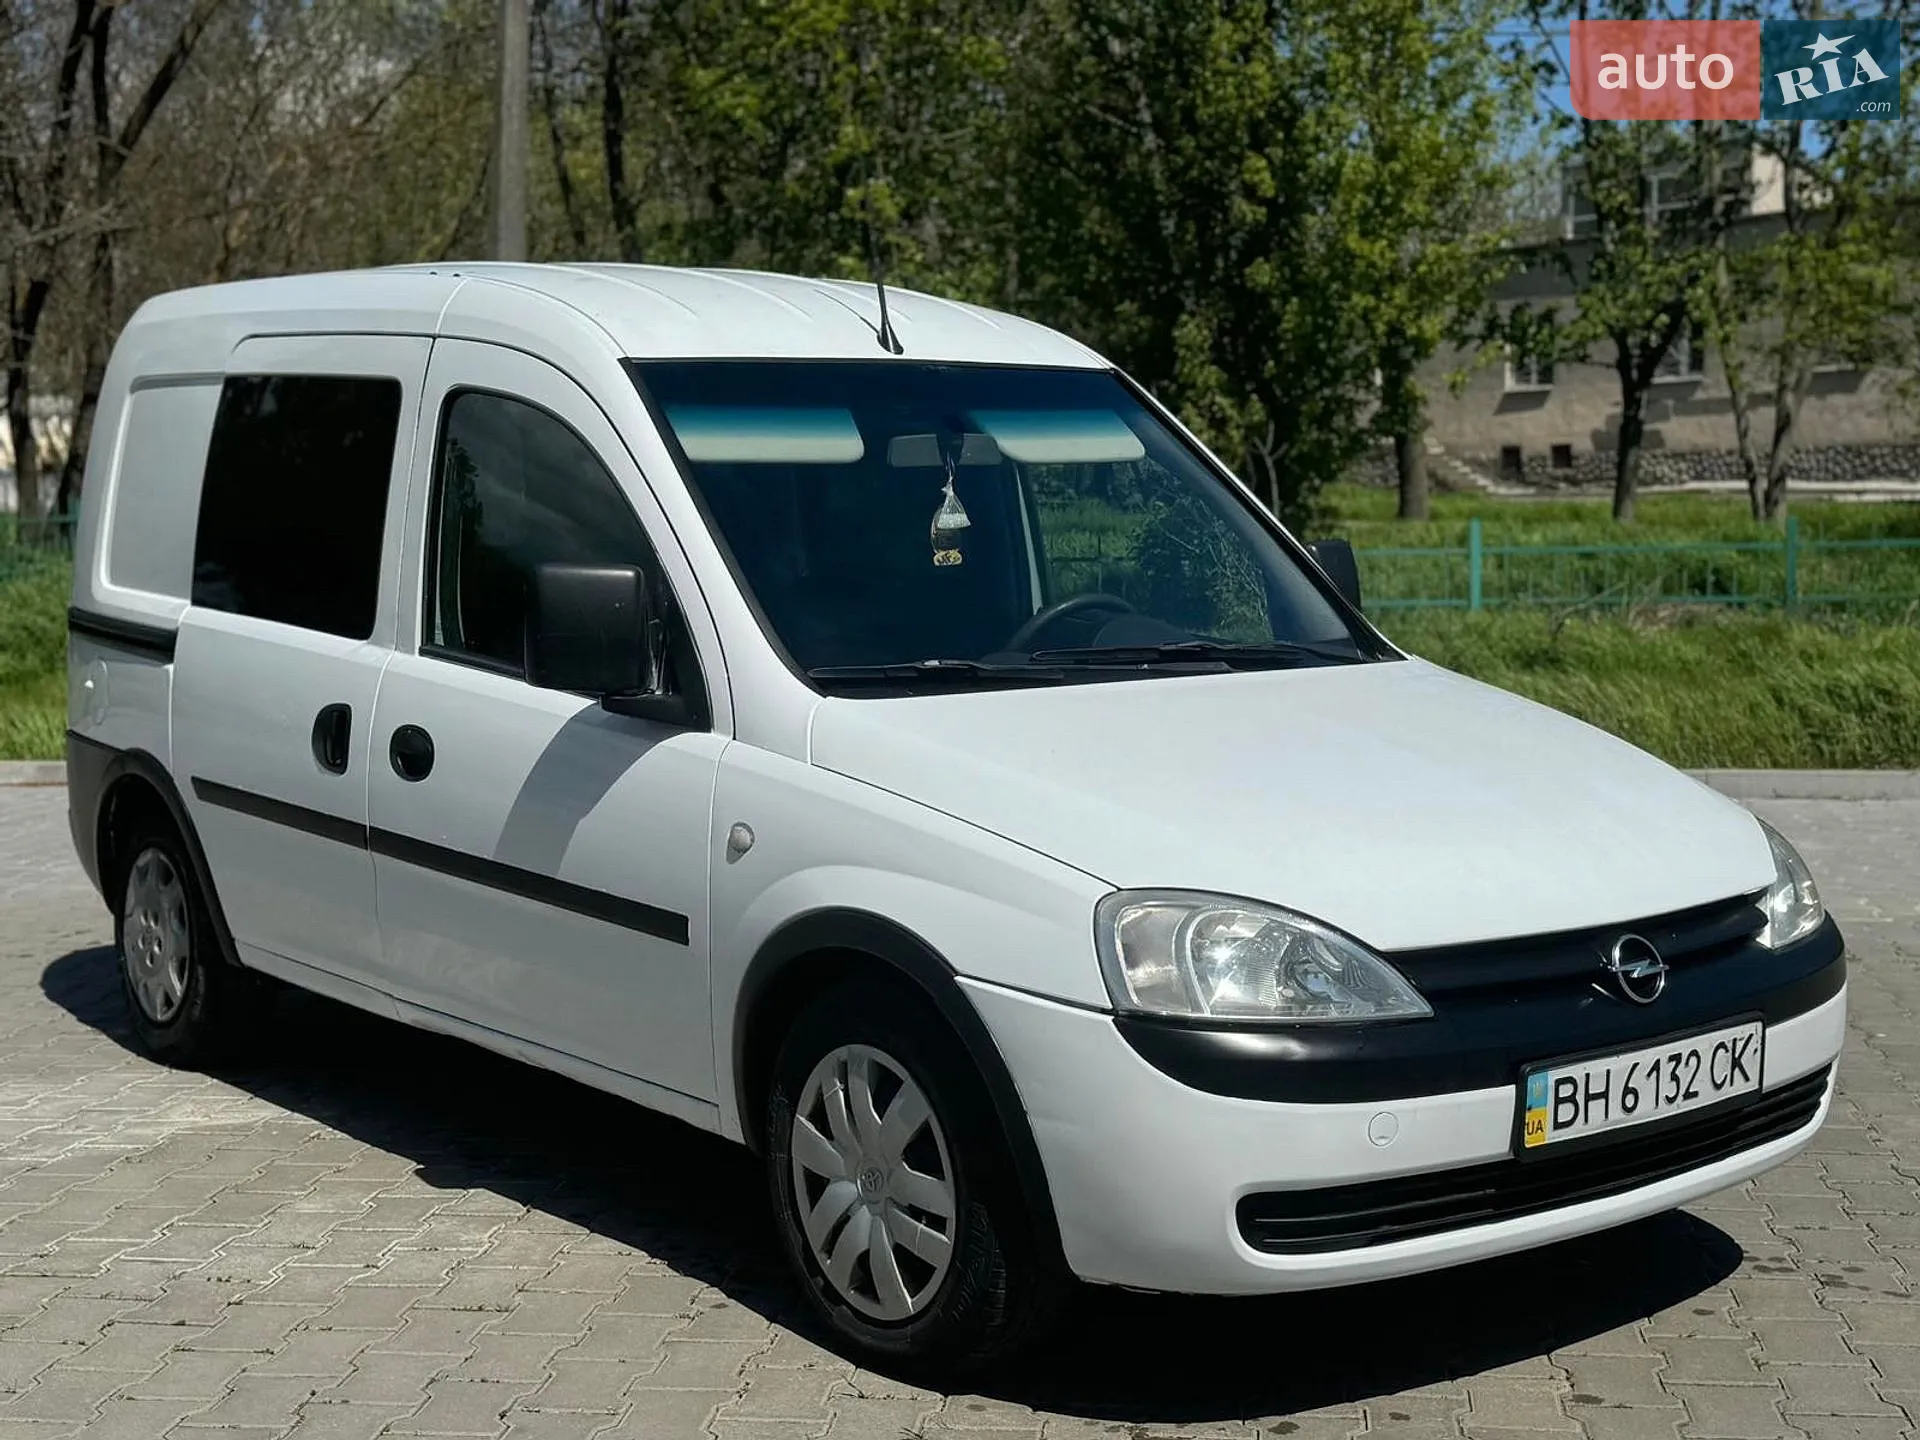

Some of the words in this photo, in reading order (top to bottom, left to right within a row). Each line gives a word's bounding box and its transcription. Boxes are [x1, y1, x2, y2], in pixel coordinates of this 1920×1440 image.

[1552, 1068, 1611, 1131] BH
[1620, 1048, 1702, 1115] 6132
[1709, 1032, 1755, 1091] CK
[1525, 1118, 1545, 1136] UA
